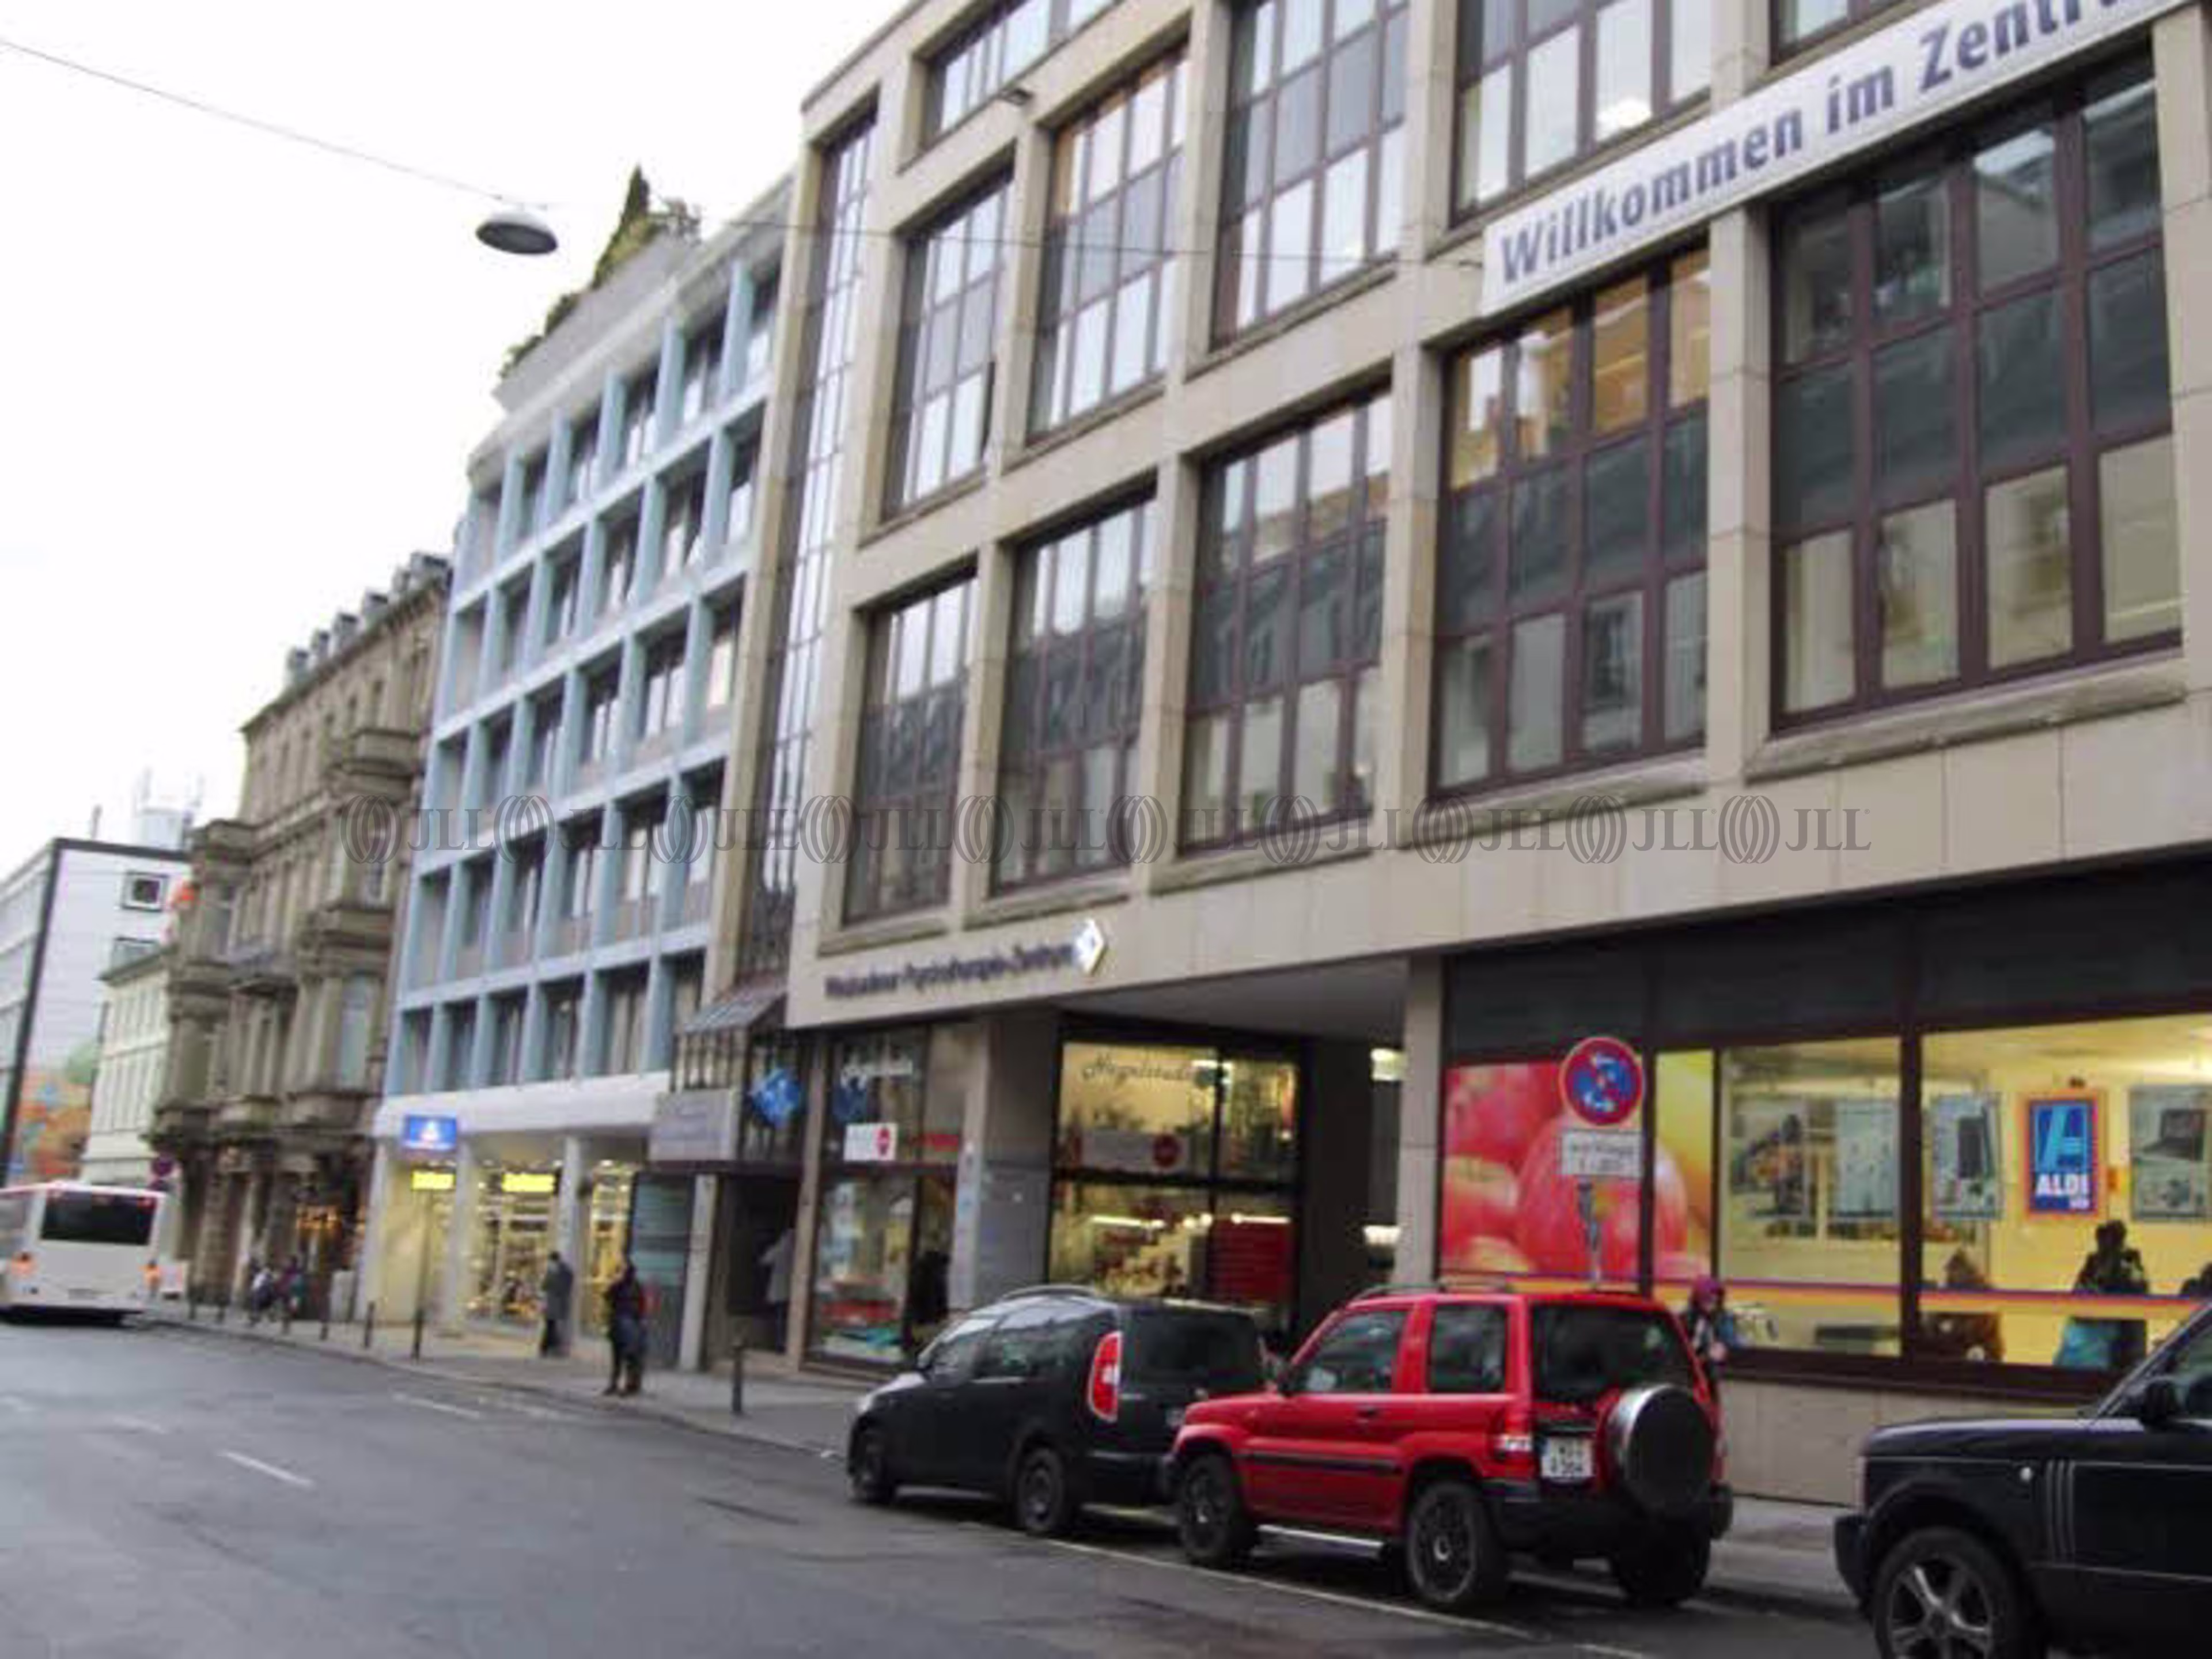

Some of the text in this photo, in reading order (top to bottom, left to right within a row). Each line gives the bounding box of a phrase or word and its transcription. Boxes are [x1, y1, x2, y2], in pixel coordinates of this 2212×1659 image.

[1500, 112, 1803, 283] Willkommen
[1826, 63, 1894, 135] im
[2036, 1173, 2090, 1196] ALDI
